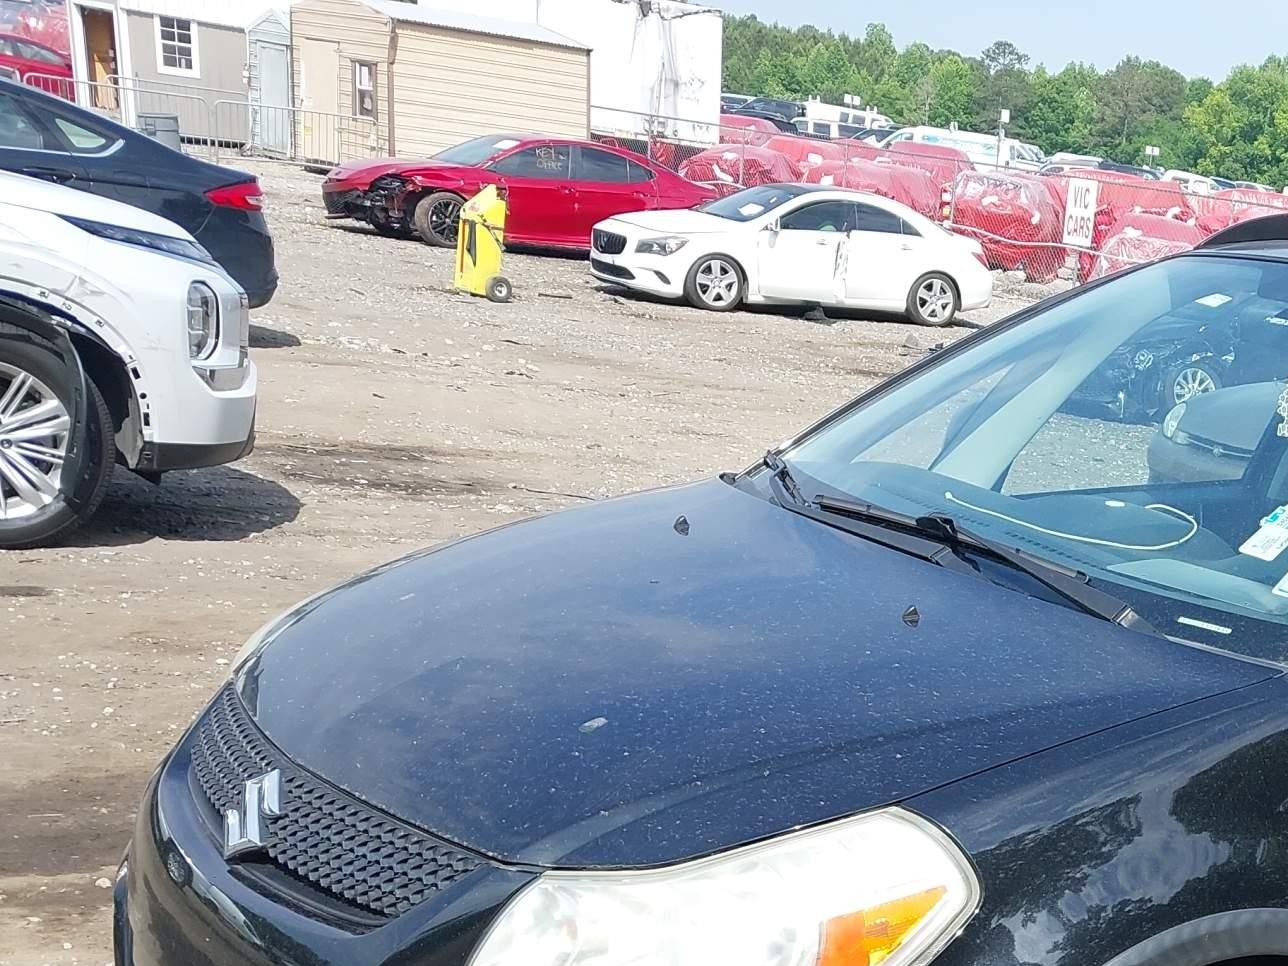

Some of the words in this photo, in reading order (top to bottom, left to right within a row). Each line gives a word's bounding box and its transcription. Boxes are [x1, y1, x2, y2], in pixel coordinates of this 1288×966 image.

[535, 146, 555, 160] KEY
[1074, 186, 1090, 209] VIC
[1067, 214, 1091, 239] CARS
